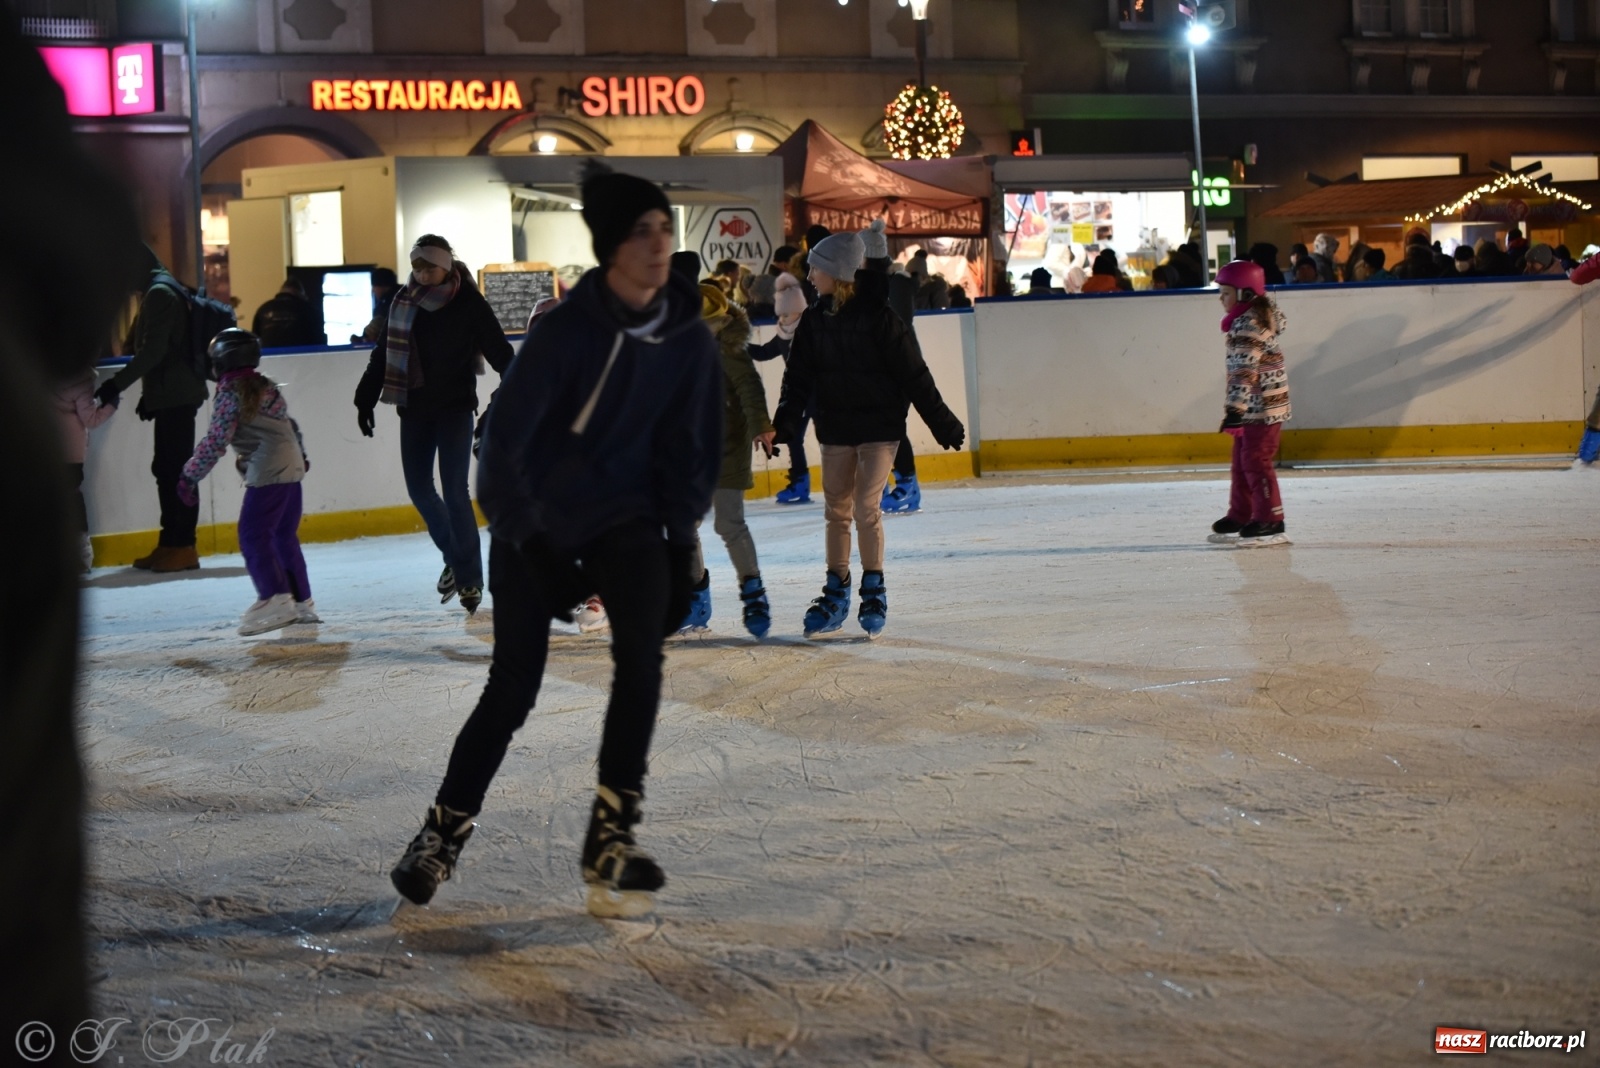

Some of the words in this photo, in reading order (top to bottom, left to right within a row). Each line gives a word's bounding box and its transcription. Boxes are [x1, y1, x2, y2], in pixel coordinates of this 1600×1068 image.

[312, 79, 523, 111] RESTAURACJA
[582, 75, 706, 116] SHIRO
[895, 210, 905, 229] Z
[709, 241, 764, 260] PYSZNA
